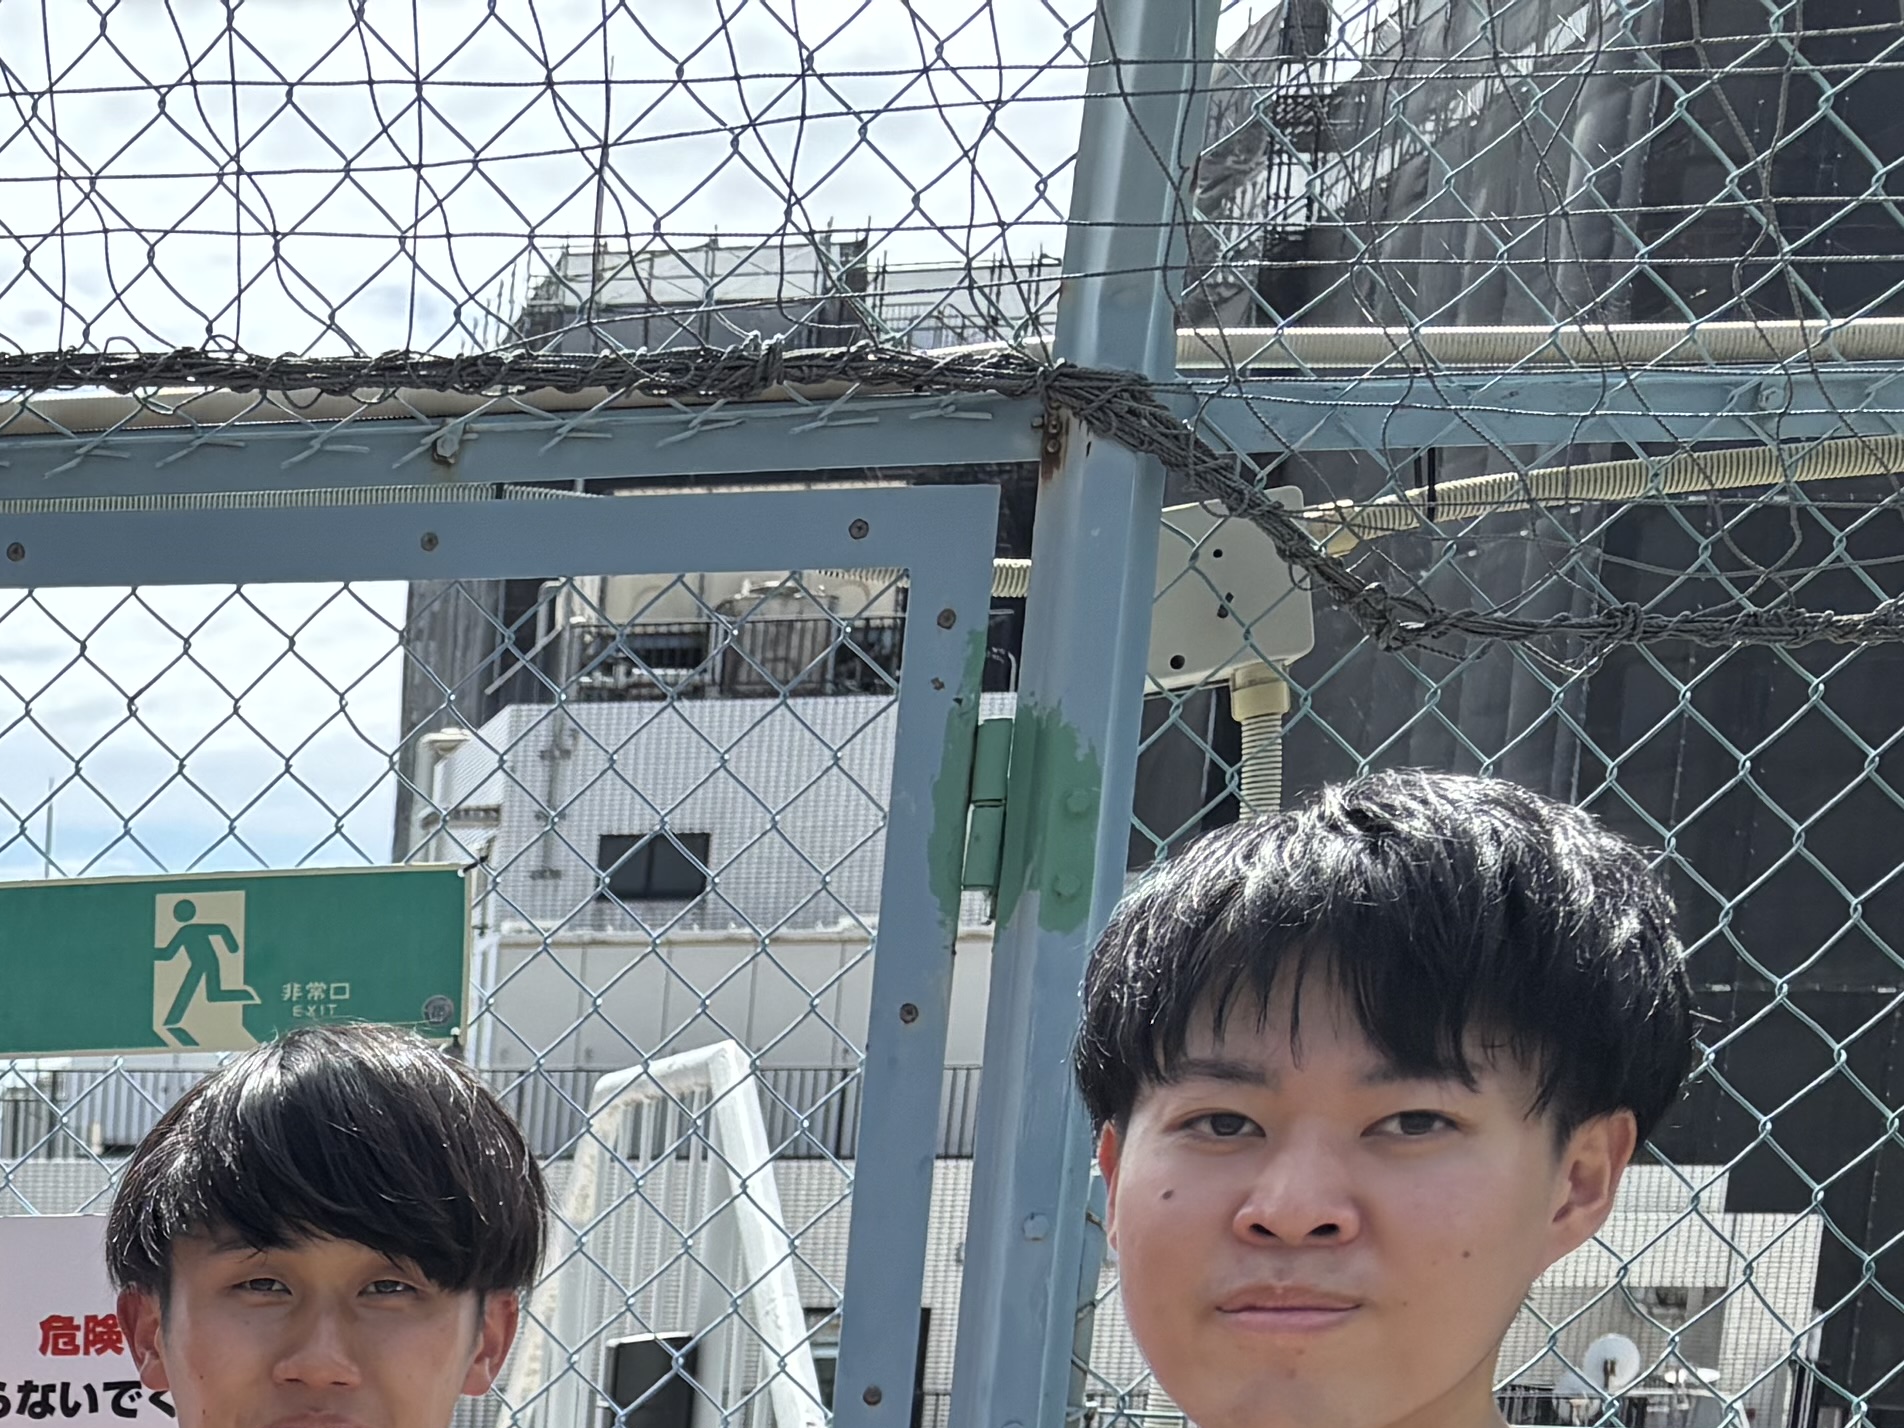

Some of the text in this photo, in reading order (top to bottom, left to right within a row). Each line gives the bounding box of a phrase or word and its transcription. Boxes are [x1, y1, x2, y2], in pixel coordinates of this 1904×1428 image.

[283, 982, 350, 1001] 非常口
[293, 1004, 338, 1017] EXIT
[39, 1314, 124, 1356] 危険
